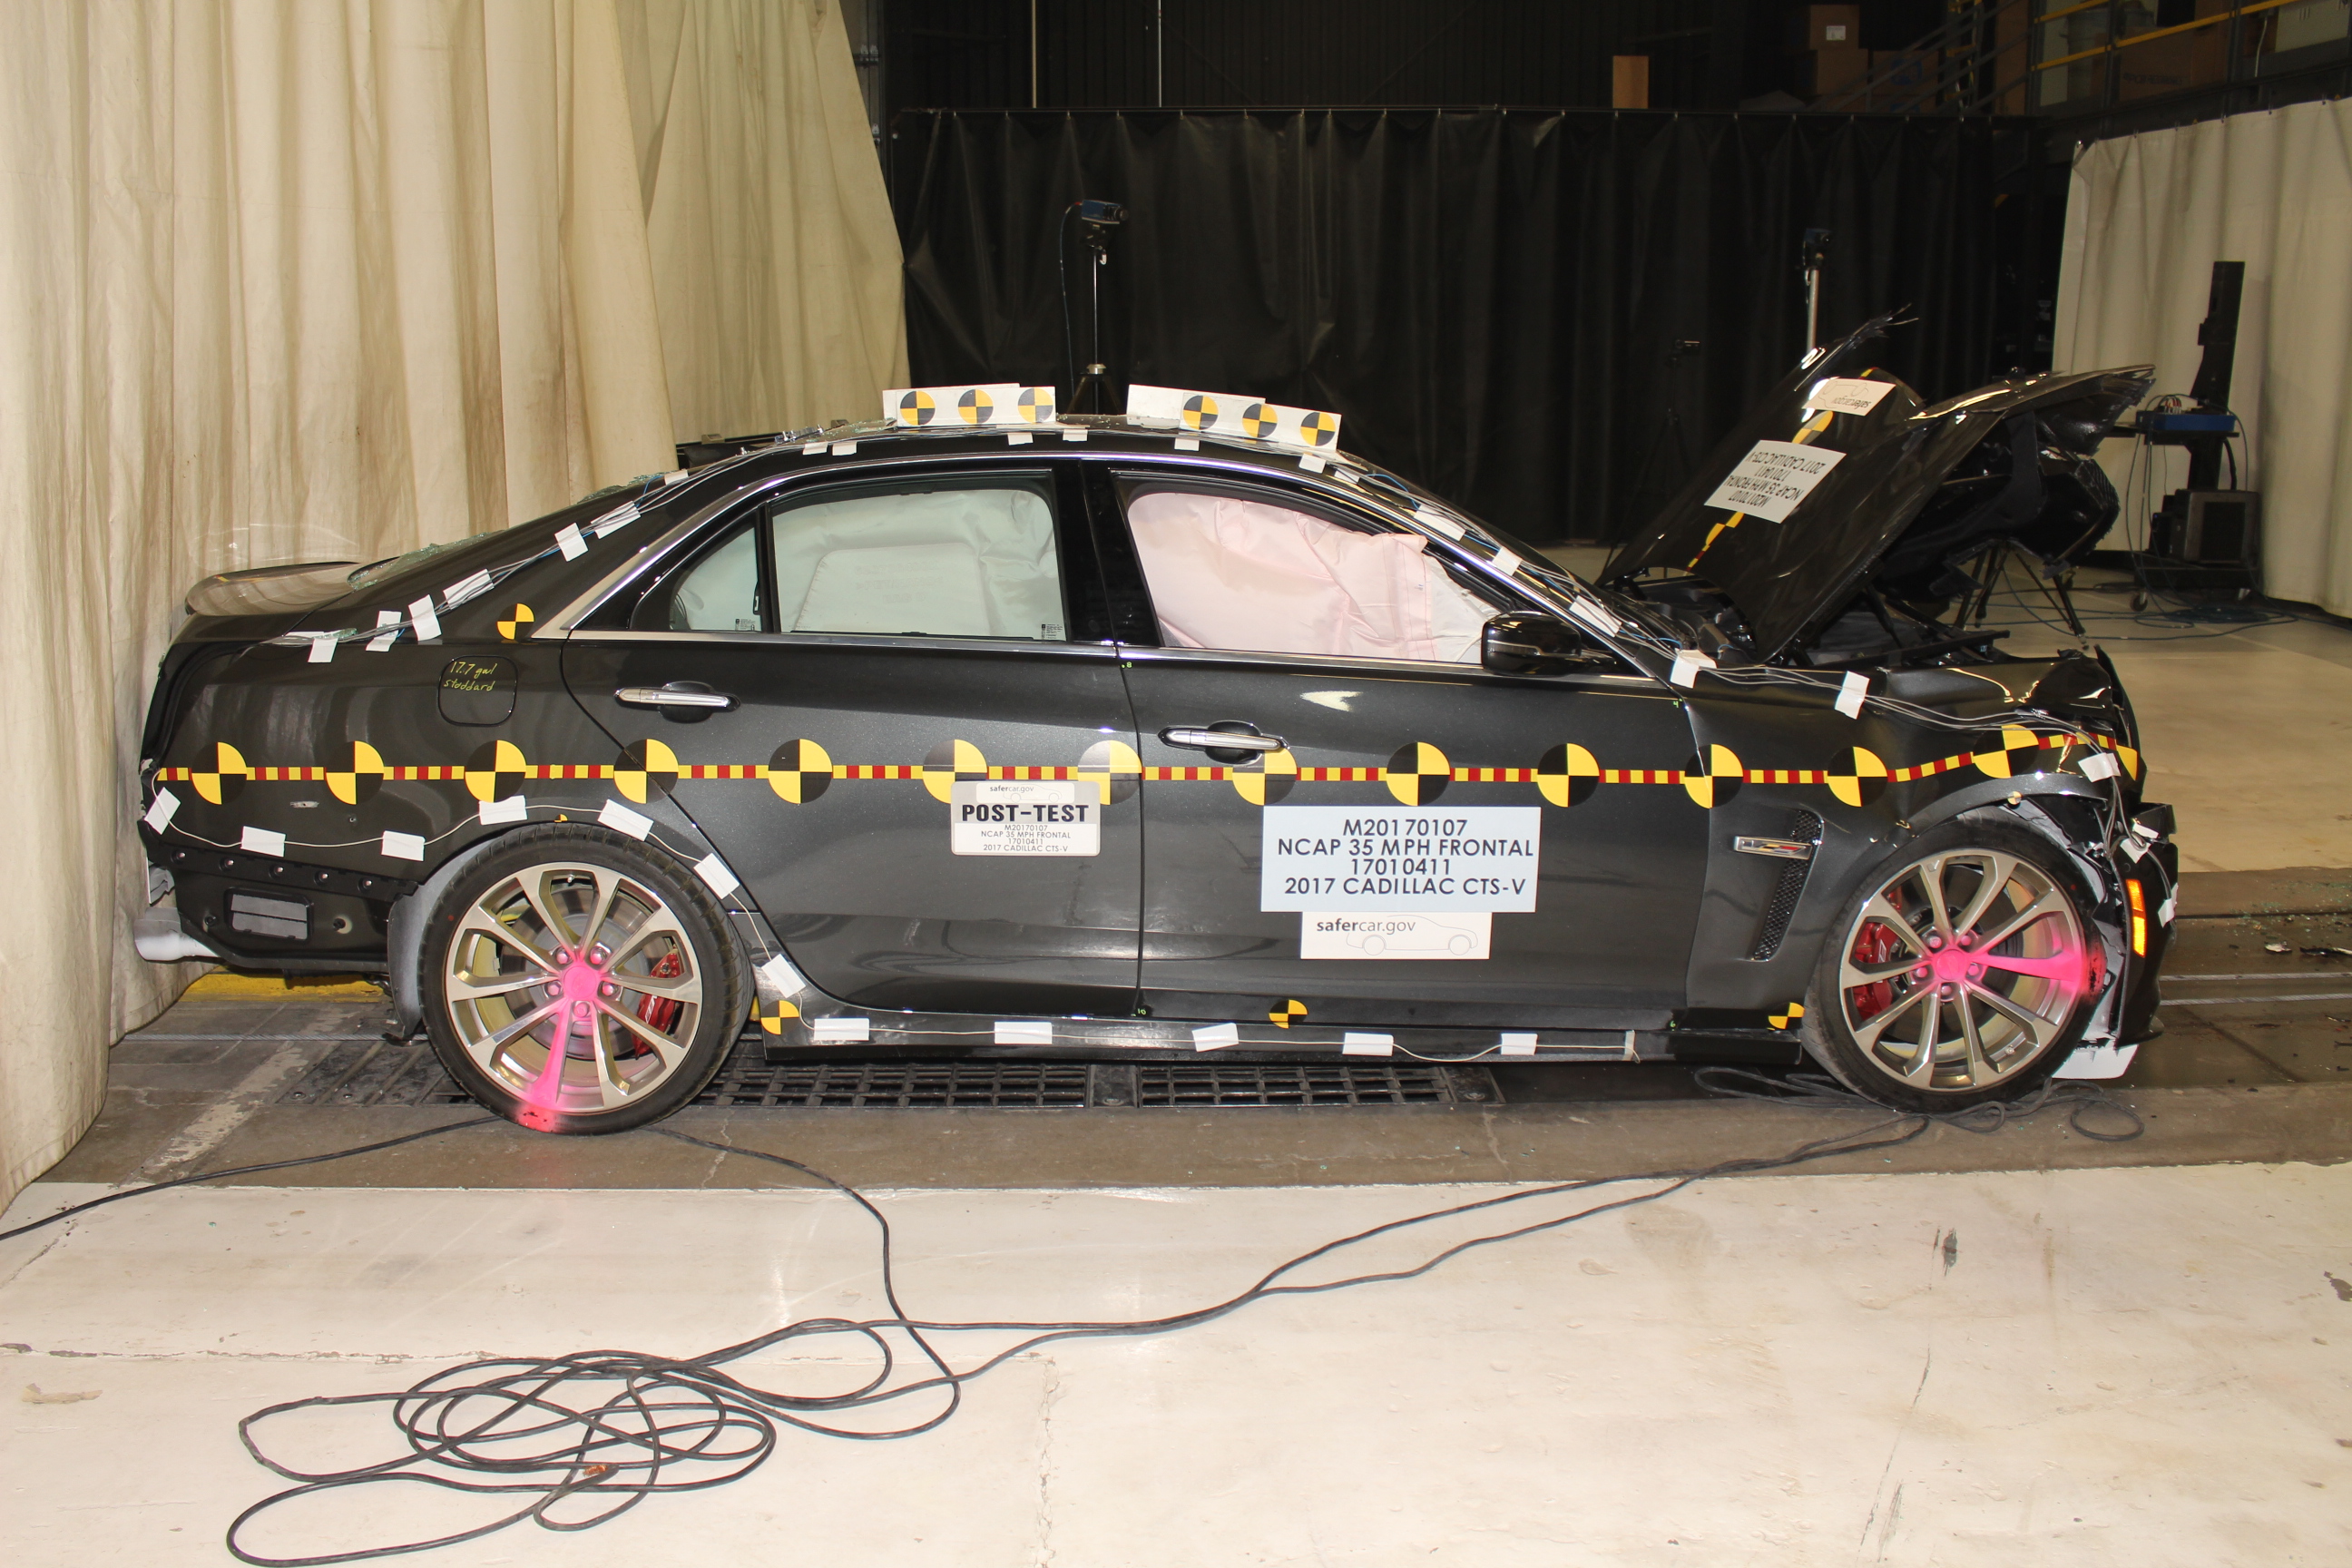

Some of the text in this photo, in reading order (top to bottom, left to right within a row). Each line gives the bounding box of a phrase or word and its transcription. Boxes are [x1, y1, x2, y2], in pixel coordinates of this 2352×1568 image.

[1764, 453, 1806, 470] CADILLAC
[1800, 460, 1827, 475] 2017
[1749, 479, 1770, 493] MPH
[1776, 485, 1805, 502] NCAP
[1728, 490, 1772, 508] M20170107
[989, 784, 1034, 793] safercar.gov
[962, 804, 1090, 823] POST-TEST
[1036, 831, 1072, 839] FRONTAL
[1342, 818, 1468, 838] M20170107
[1045, 845, 1069, 853] CTS-V
[1277, 838, 1534, 857] NCAP 35 MPH FRONTAL
[1351, 858, 1451, 876] 17010411
[1284, 877, 1527, 896] 2017 CADILLAC CTS-V
[1316, 917, 1416, 936] safercar.gov
